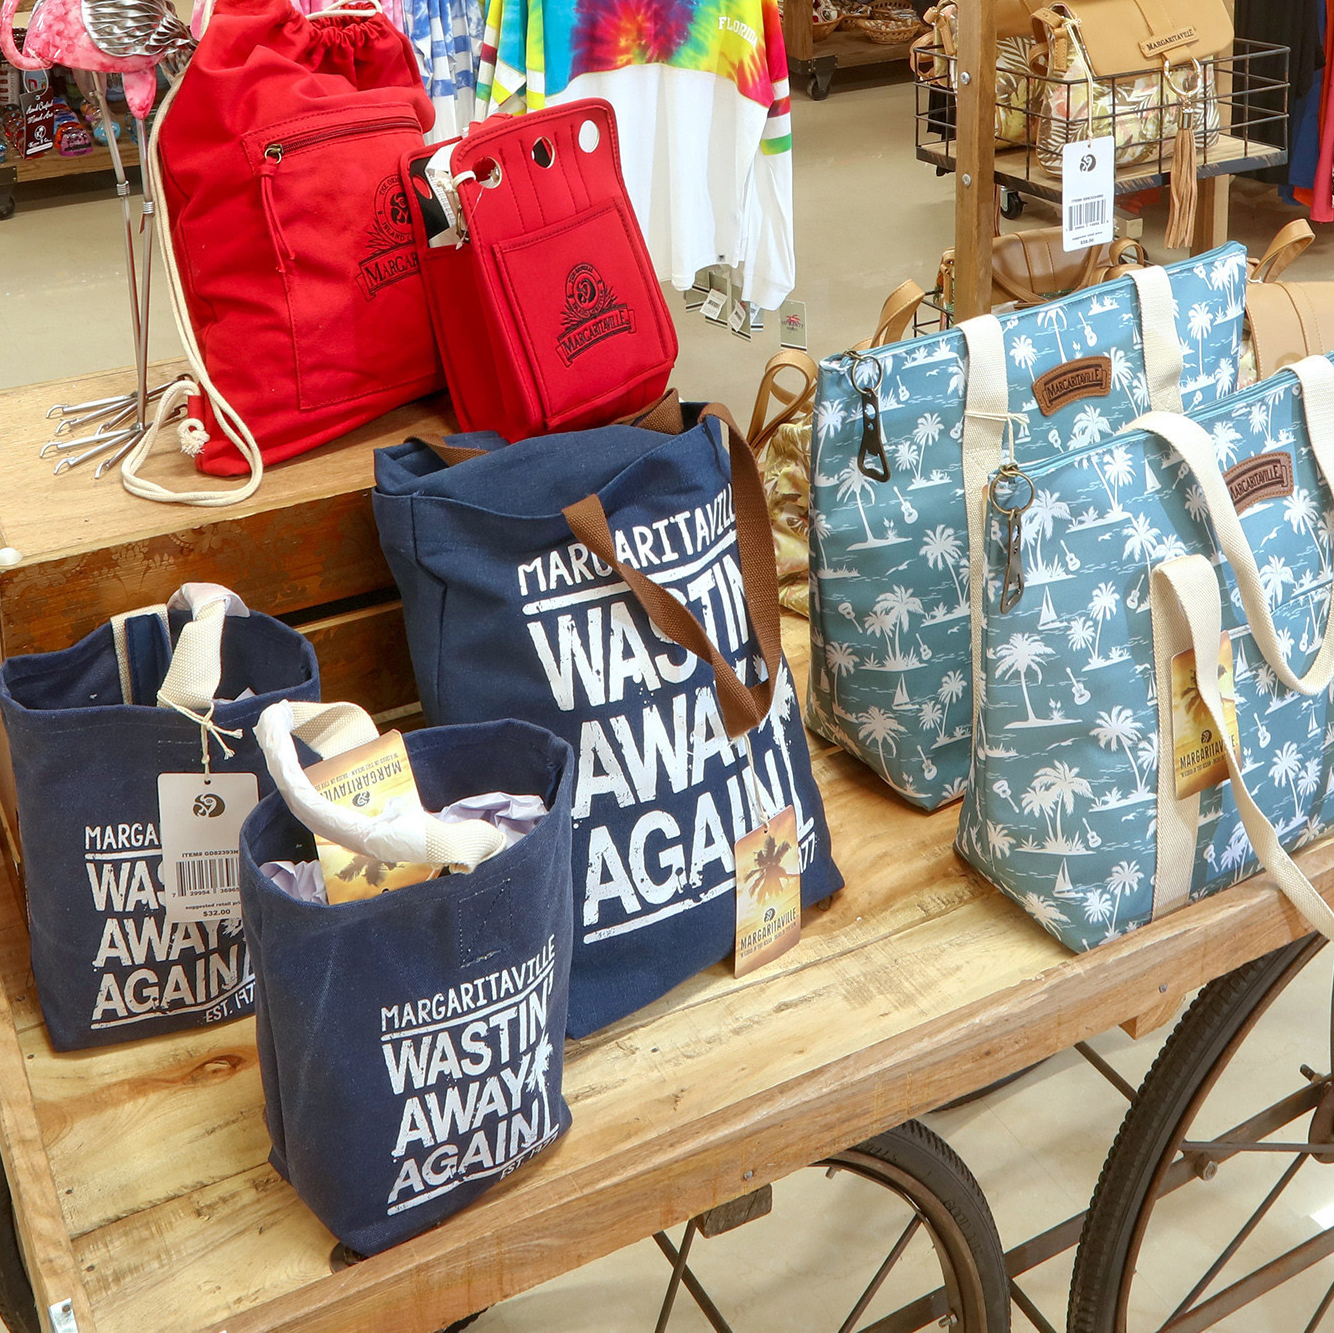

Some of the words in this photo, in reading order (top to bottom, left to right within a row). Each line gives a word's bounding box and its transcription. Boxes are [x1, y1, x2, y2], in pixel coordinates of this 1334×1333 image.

[718, 16, 758, 48] FLORIDA
[1047, 369, 1100, 398] MARGARITAVILLE
[519, 481, 736, 596] MARGARITAVILL
[527, 552, 750, 711] WASTIN
[320, 760, 402, 802] MARGARITAVIL
[583, 749, 785, 927] AGAIN
[92, 916, 223, 968] AWAY
[203, 909, 231, 917] $32.00
[741, 907, 797, 951] MARGARITAVILLE
[91, 944, 238, 1021] AGAIN
[205, 1003, 234, 1023] EST.
[236, 982, 257, 1010] 197
[381, 934, 556, 1032] MARGARITAVILLE
[382, 970, 555, 1096] WASTIN'
[391, 1054, 532, 1157] AWAY
[387, 1098, 539, 1205] AGAIN
[500, 1162, 525, 1181] EST.
